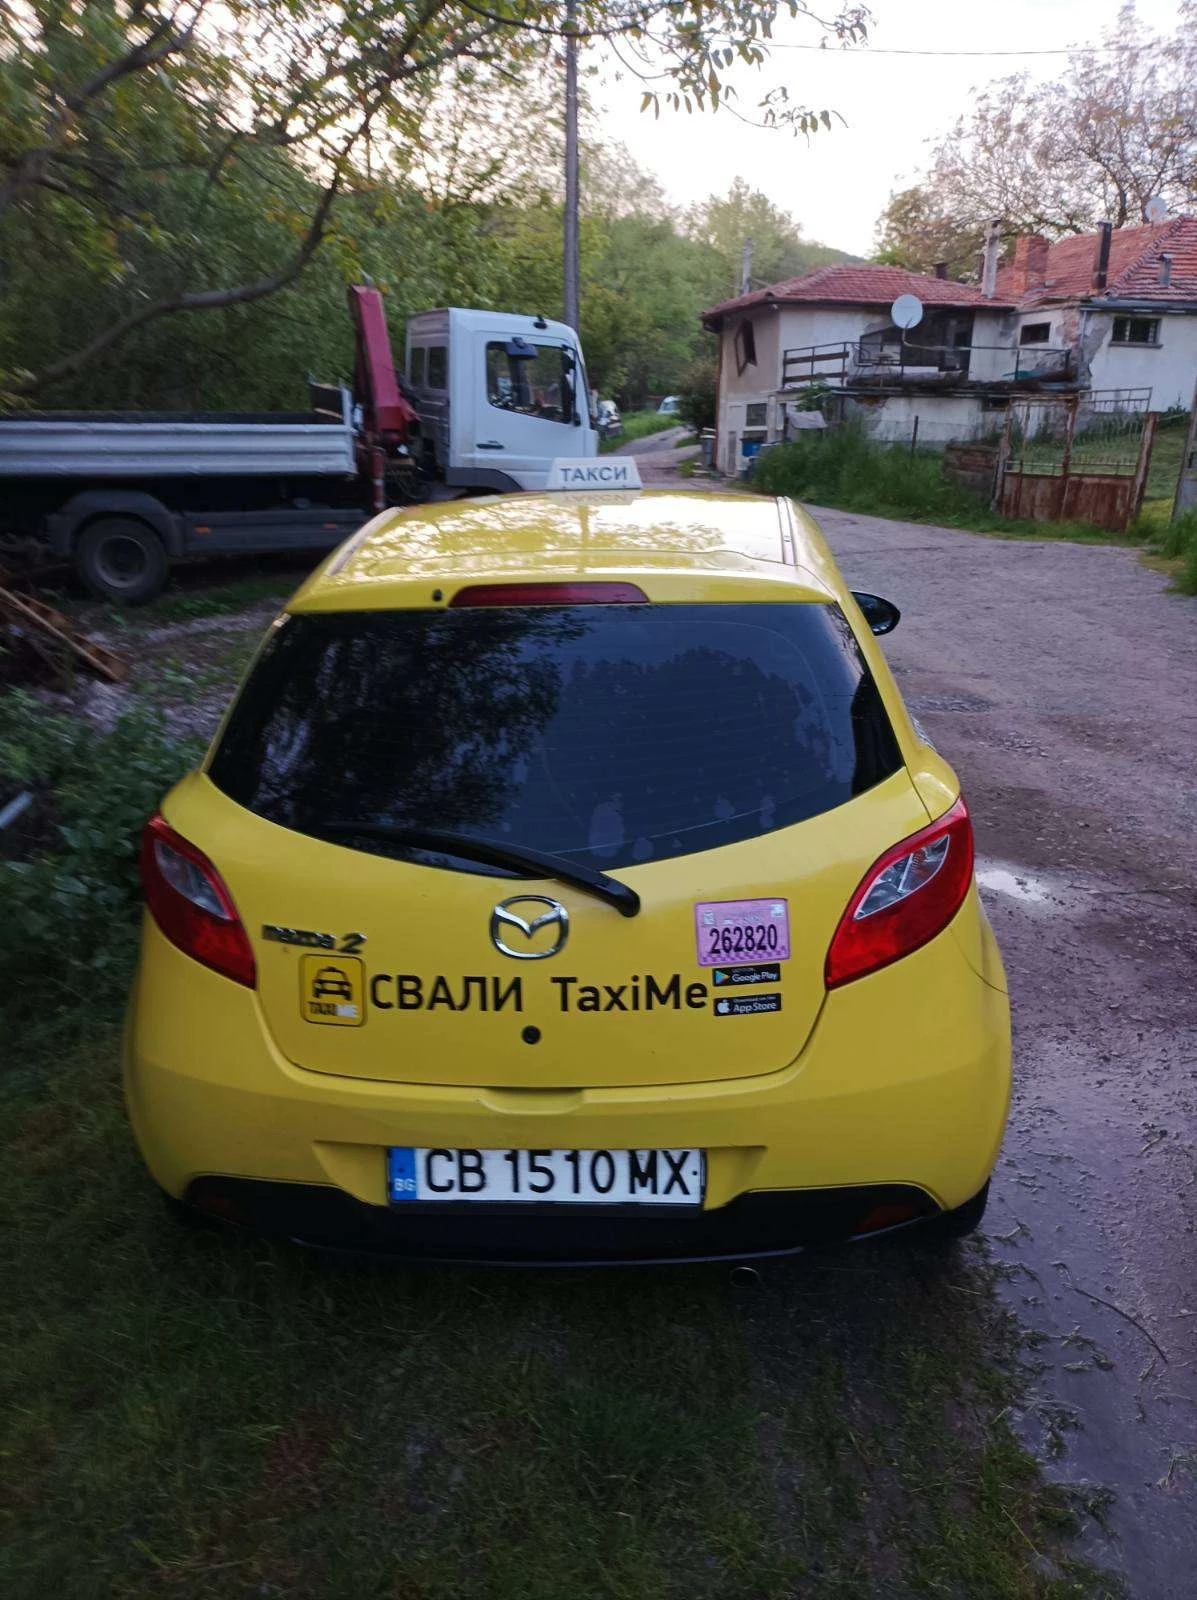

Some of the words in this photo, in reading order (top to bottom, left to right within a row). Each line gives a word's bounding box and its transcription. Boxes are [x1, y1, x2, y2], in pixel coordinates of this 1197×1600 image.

[560, 466, 627, 482] ТАКСИ
[709, 923, 778, 954] 262820
[732, 973, 761, 983] Google
[761, 971, 778, 981] Play
[370, 973, 523, 1012] СВАЛИ
[550, 973, 708, 1012] TaxiMe
[734, 1004, 752, 1014] App
[752, 1001, 777, 1011] Store
[504, 1149, 616, 1194] 1510
[629, 1149, 691, 1196] MX
[394, 1178, 416, 1192] BG
